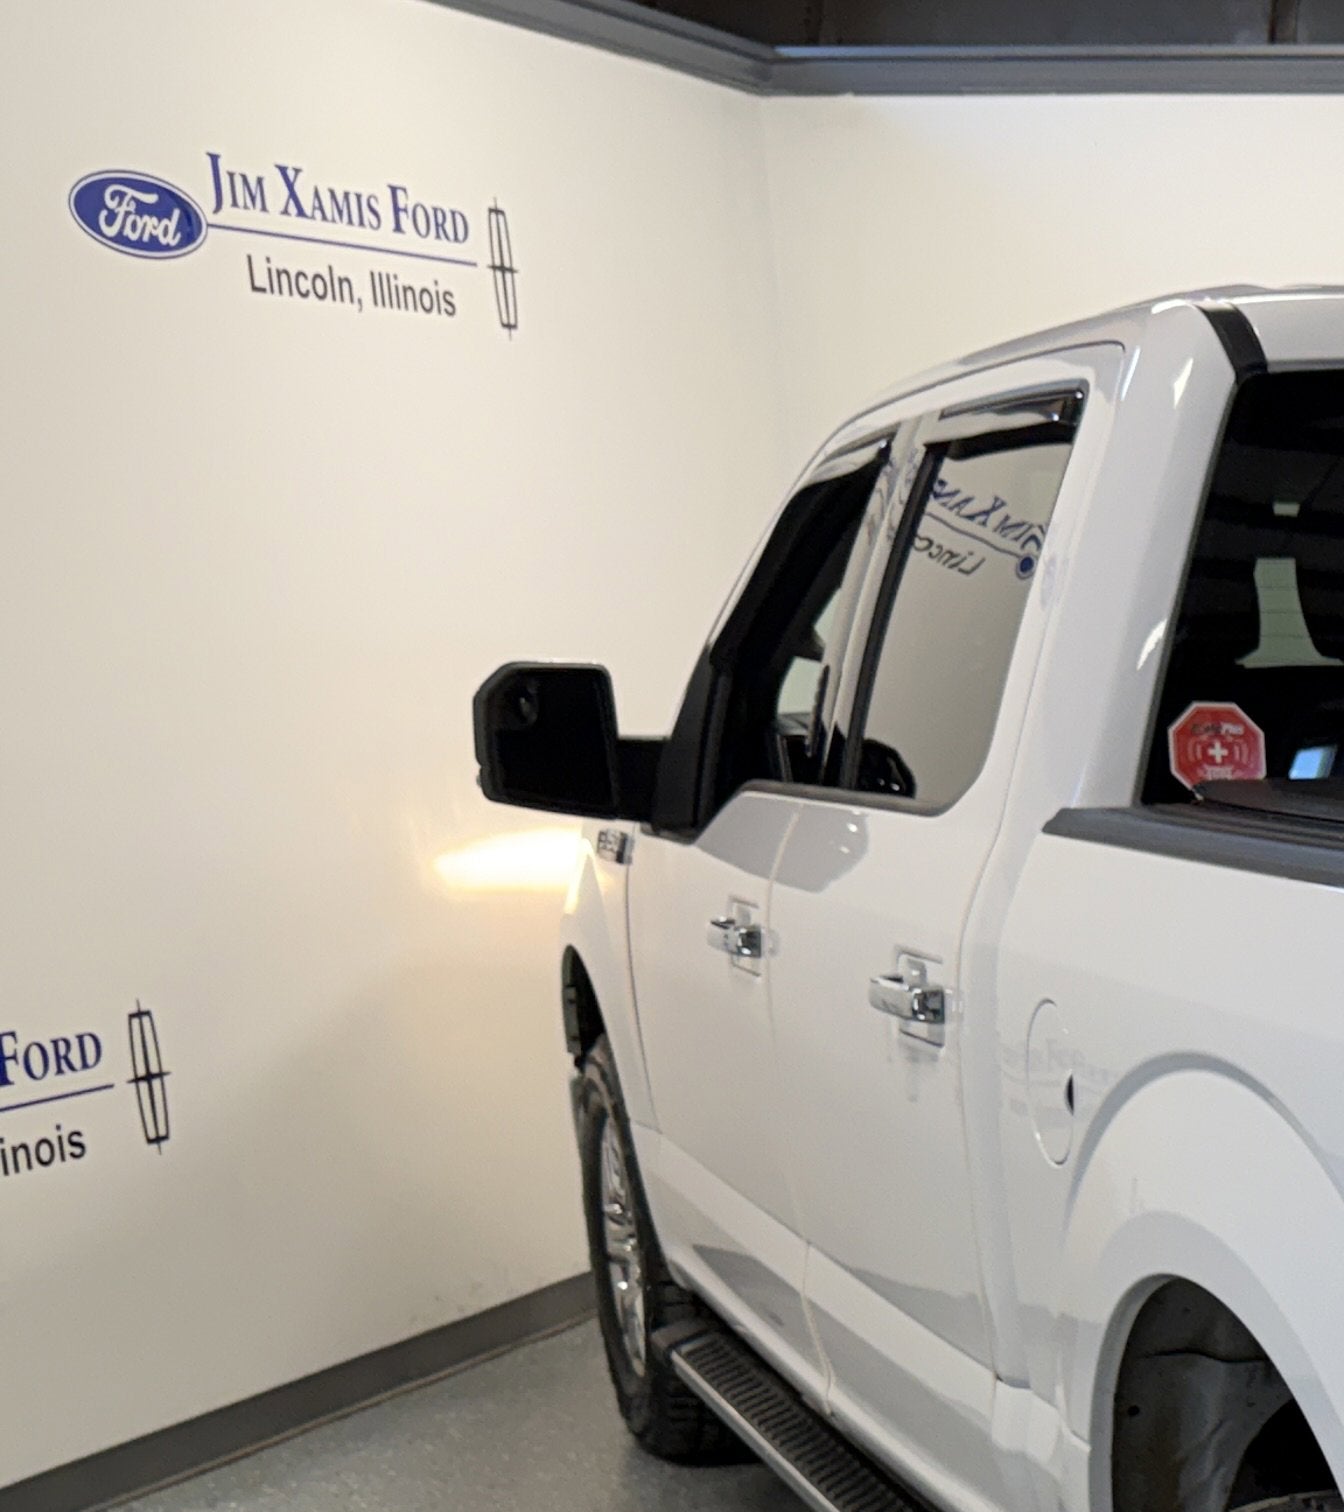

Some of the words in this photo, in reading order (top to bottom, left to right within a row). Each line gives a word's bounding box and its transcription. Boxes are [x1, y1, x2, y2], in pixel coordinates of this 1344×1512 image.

[100, 182, 183, 248] Ford
[246, 253, 364, 313] Lincoln,
[370, 270, 457, 318] Illinois
